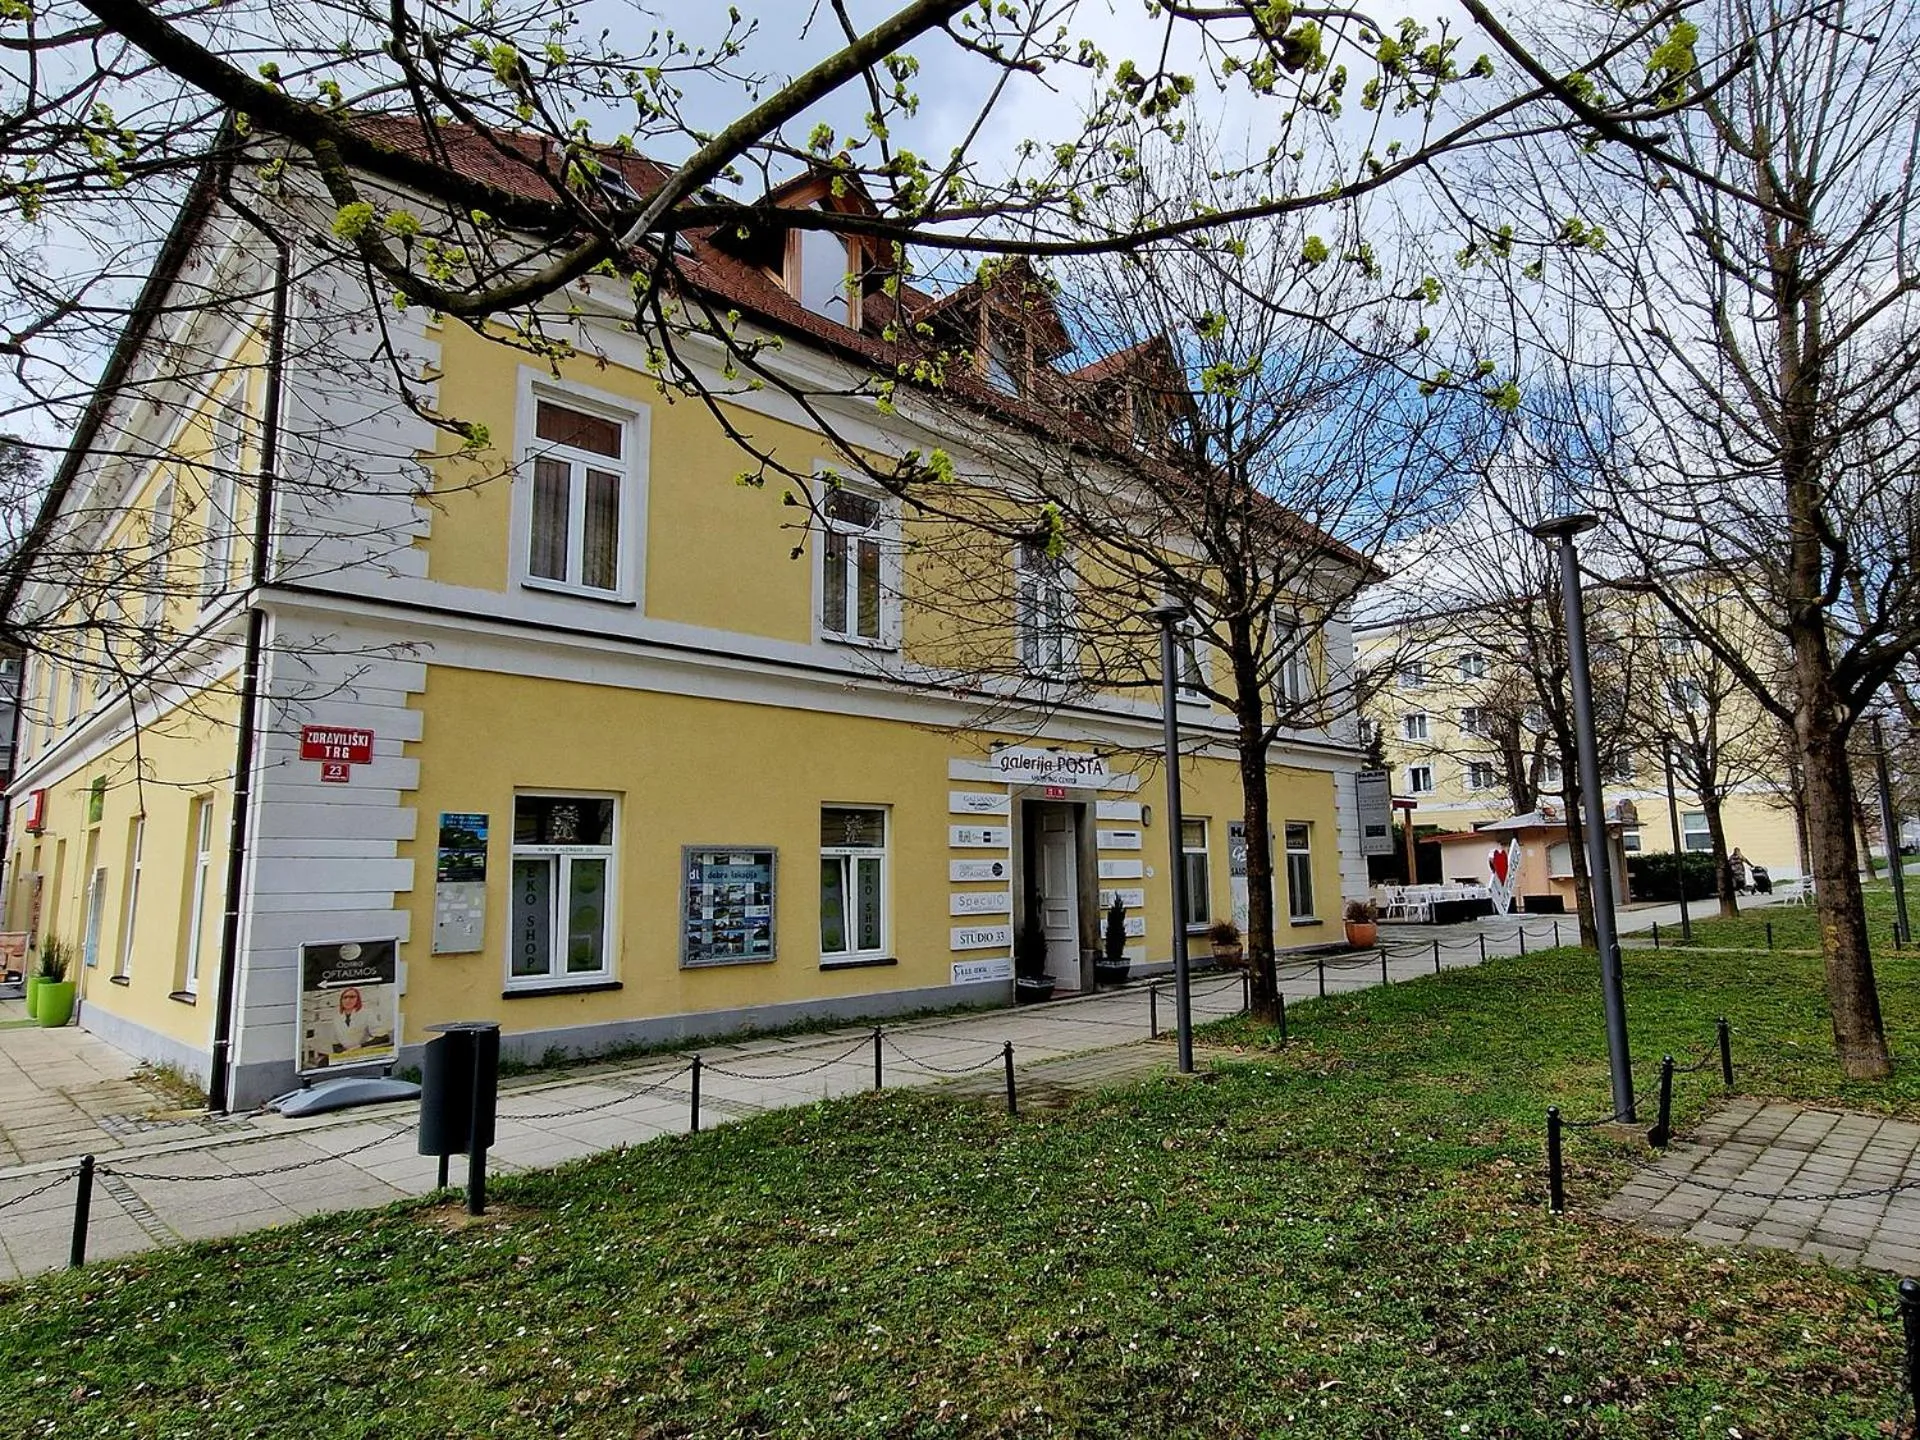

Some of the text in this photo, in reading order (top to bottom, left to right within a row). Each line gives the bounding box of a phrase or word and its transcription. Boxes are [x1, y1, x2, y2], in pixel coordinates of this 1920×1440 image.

[306, 731, 369, 747] ZDRAVILIŠKI
[325, 745, 350, 759] TRG
[329, 765, 341, 775] 23
[1000, 754, 1104, 775] galerija POŠTA
[524, 867, 537, 905] EKO
[524, 915, 536, 969] SHOP
[960, 931, 1005, 945] STUDIO 33
[322, 966, 377, 980] OFTALMOS
